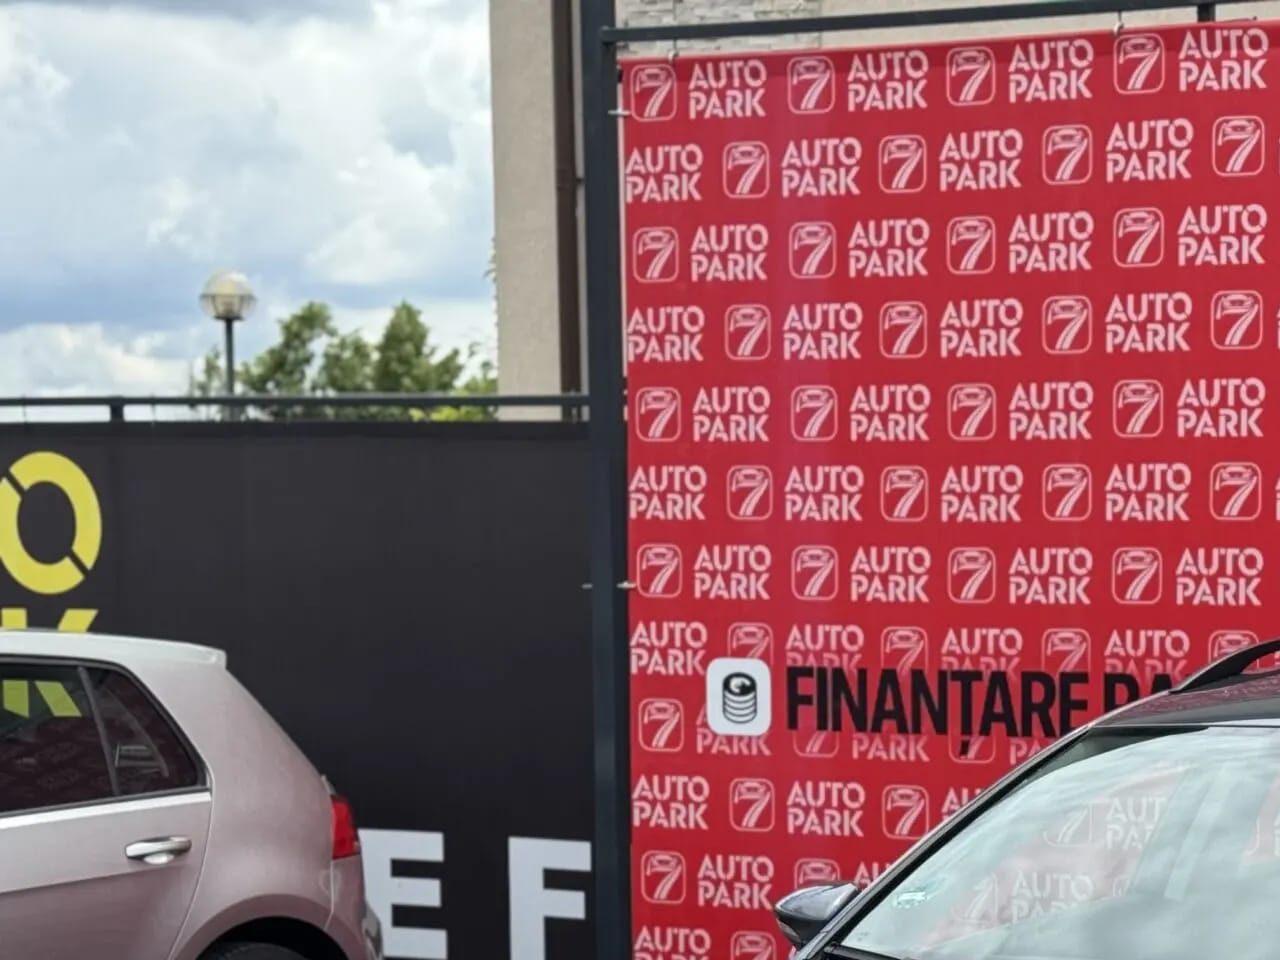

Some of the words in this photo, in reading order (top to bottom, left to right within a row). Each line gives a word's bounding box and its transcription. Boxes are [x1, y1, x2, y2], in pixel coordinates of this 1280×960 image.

[1009, 39, 1093, 71] AUTO
[1178, 28, 1268, 59] AUTO
[689, 59, 766, 89] AUTO
[847, 50, 928, 80] AUTO
[1180, 59, 1266, 91] PARK
[848, 79, 927, 111] PARK
[1010, 69, 1092, 103] PARK
[690, 88, 765, 119] PARK
[940, 129, 1023, 161] AUTO
[1106, 118, 1193, 151] AUTO
[626, 143, 703, 174] AUTO
[782, 137, 862, 168] AUTO
[1107, 149, 1191, 182] PARK
[626, 174, 701, 203] PARK
[782, 166, 860, 197] PARK
[940, 159, 1021, 191] PARK
[848, 218, 929, 248] AUTO
[1009, 211, 1094, 242] AUTO
[1178, 204, 1267, 235] AUTO
[691, 224, 768, 252] AUTO
[1179, 235, 1264, 266] PARK
[692, 253, 767, 281] PARK
[849, 248, 928, 277] PARK
[1010, 241, 1091, 273] PARK
[627, 305, 704, 334] AUTO
[783, 302, 863, 330] AUTO
[940, 298, 1023, 328] AUTO
[1105, 292, 1192, 322] AUTO
[627, 334, 703, 363] PARK
[784, 331, 860, 360] PARK
[941, 328, 1021, 358] PARK
[1106, 322, 1190, 353] PARK
[693, 386, 770, 413] AUTO
[850, 384, 930, 412] AUTO
[1009, 381, 1093, 410] AUTO
[1178, 378, 1265, 407] AUTO
[694, 414, 768, 442] PARK
[851, 413, 929, 441] PARK
[1010, 411, 1091, 440] PARK
[1178, 408, 1263, 437] PARK
[629, 465, 707, 492] AUTO
[785, 465, 864, 492] AUTO
[941, 465, 1023, 493] AUTO
[1105, 463, 1191, 491] AUTO
[630, 493, 704, 520] PARK
[786, 494, 862, 520] PARK
[942, 494, 1021, 522] PARK
[1106, 493, 1189, 521] PARK
[694, 545, 771, 572] AUTO
[851, 547, 931, 574] AUTO
[1009, 547, 1092, 575] AUTO
[1176, 548, 1263, 576] AUTO
[695, 572, 769, 599] PARK
[851, 574, 928, 602] PARK
[1010, 576, 1090, 604] PARK
[1177, 577, 1261, 605] PARK
[630, 622, 707, 648] AUTO
[786, 625, 864, 653] AUTO
[941, 628, 1023, 656] AUTO
[1105, 630, 1190, 657] AUTO
[631, 648, 704, 676] PARK
[852, 734, 930, 762] PARK
[632, 775, 709, 802] AUTO
[787, 781, 865, 809] AUTO
[633, 801, 708, 829] PARK
[788, 807, 863, 836] PARK
[698, 855, 774, 882] AUTO
[698, 880, 771, 909] PARK
[634, 926, 711, 955] AUTO
